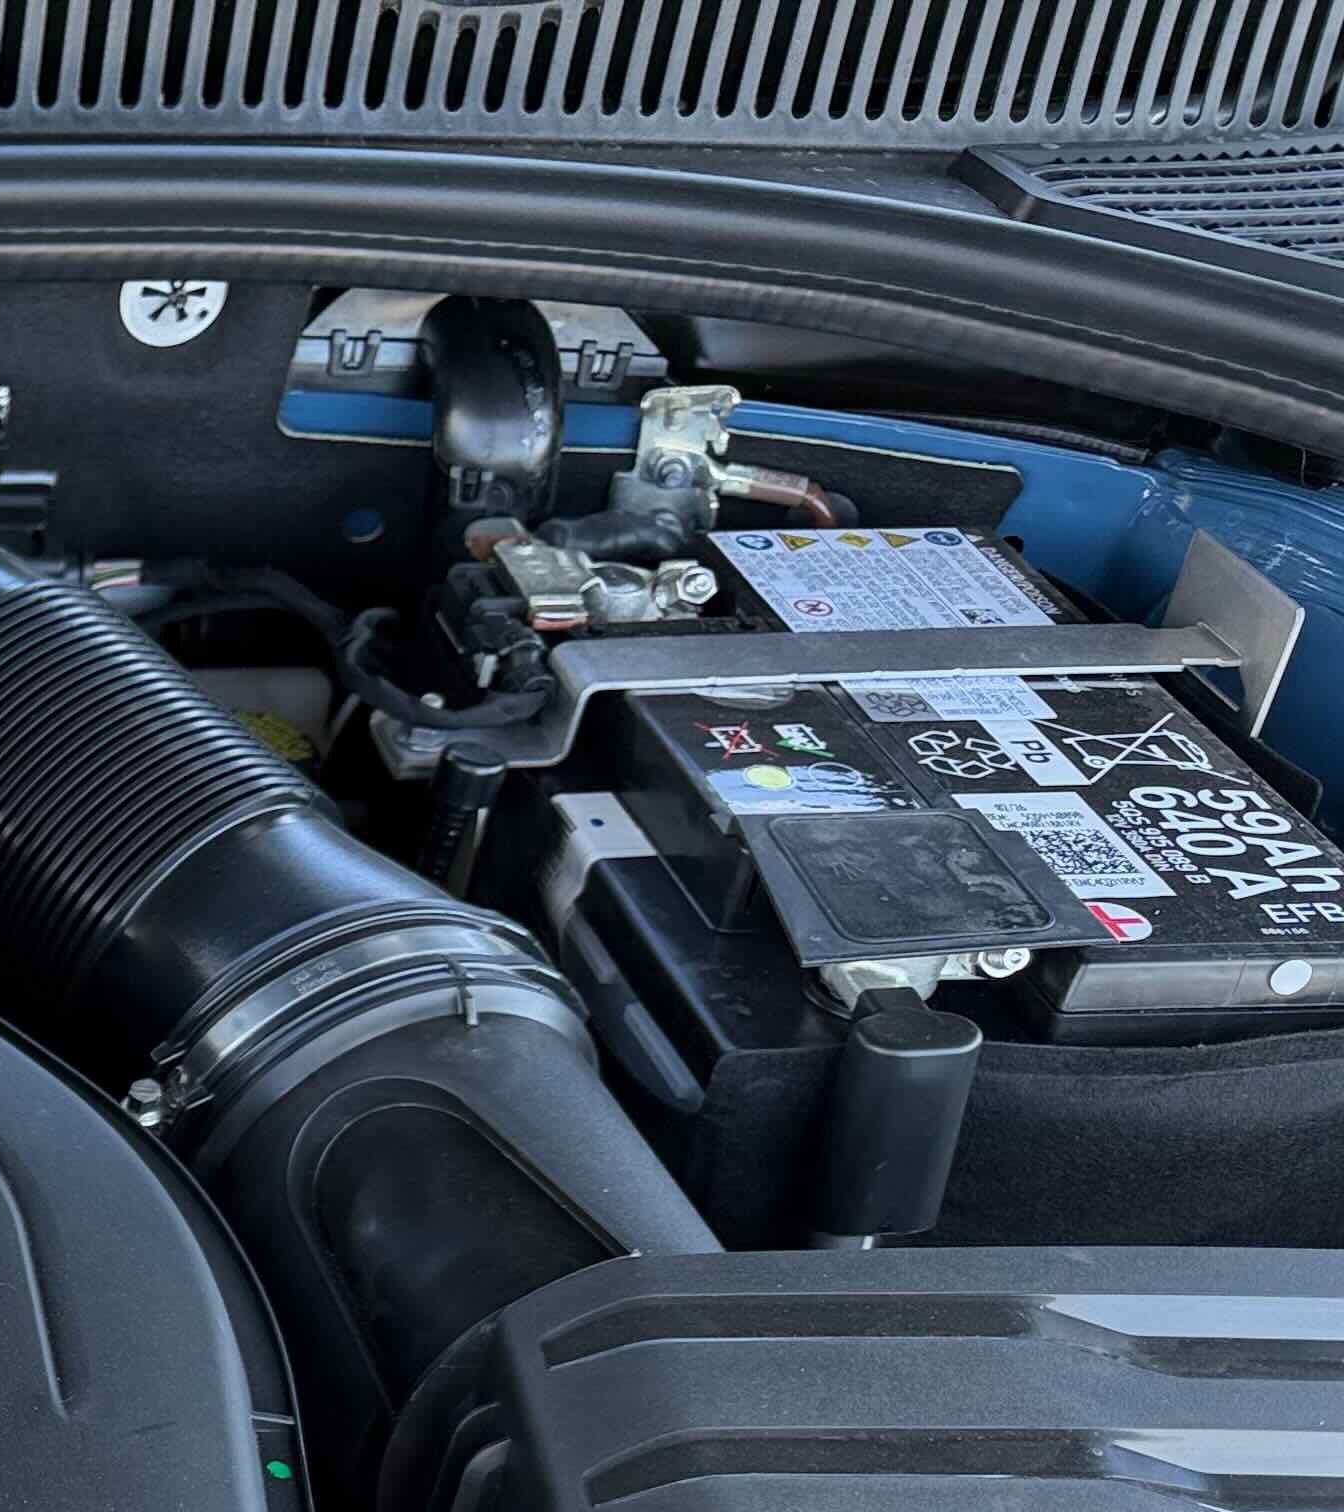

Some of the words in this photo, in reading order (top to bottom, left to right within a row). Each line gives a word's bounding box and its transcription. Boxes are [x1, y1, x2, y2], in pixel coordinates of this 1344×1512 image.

[1012, 739, 1050, 764] Pb
[1129, 786, 1247, 856] 640
[1205, 867, 1288, 900] A
[1197, 788, 1344, 893] 59Ah
[1184, 874, 1211, 884] B
[1259, 902, 1344, 923] EFB
